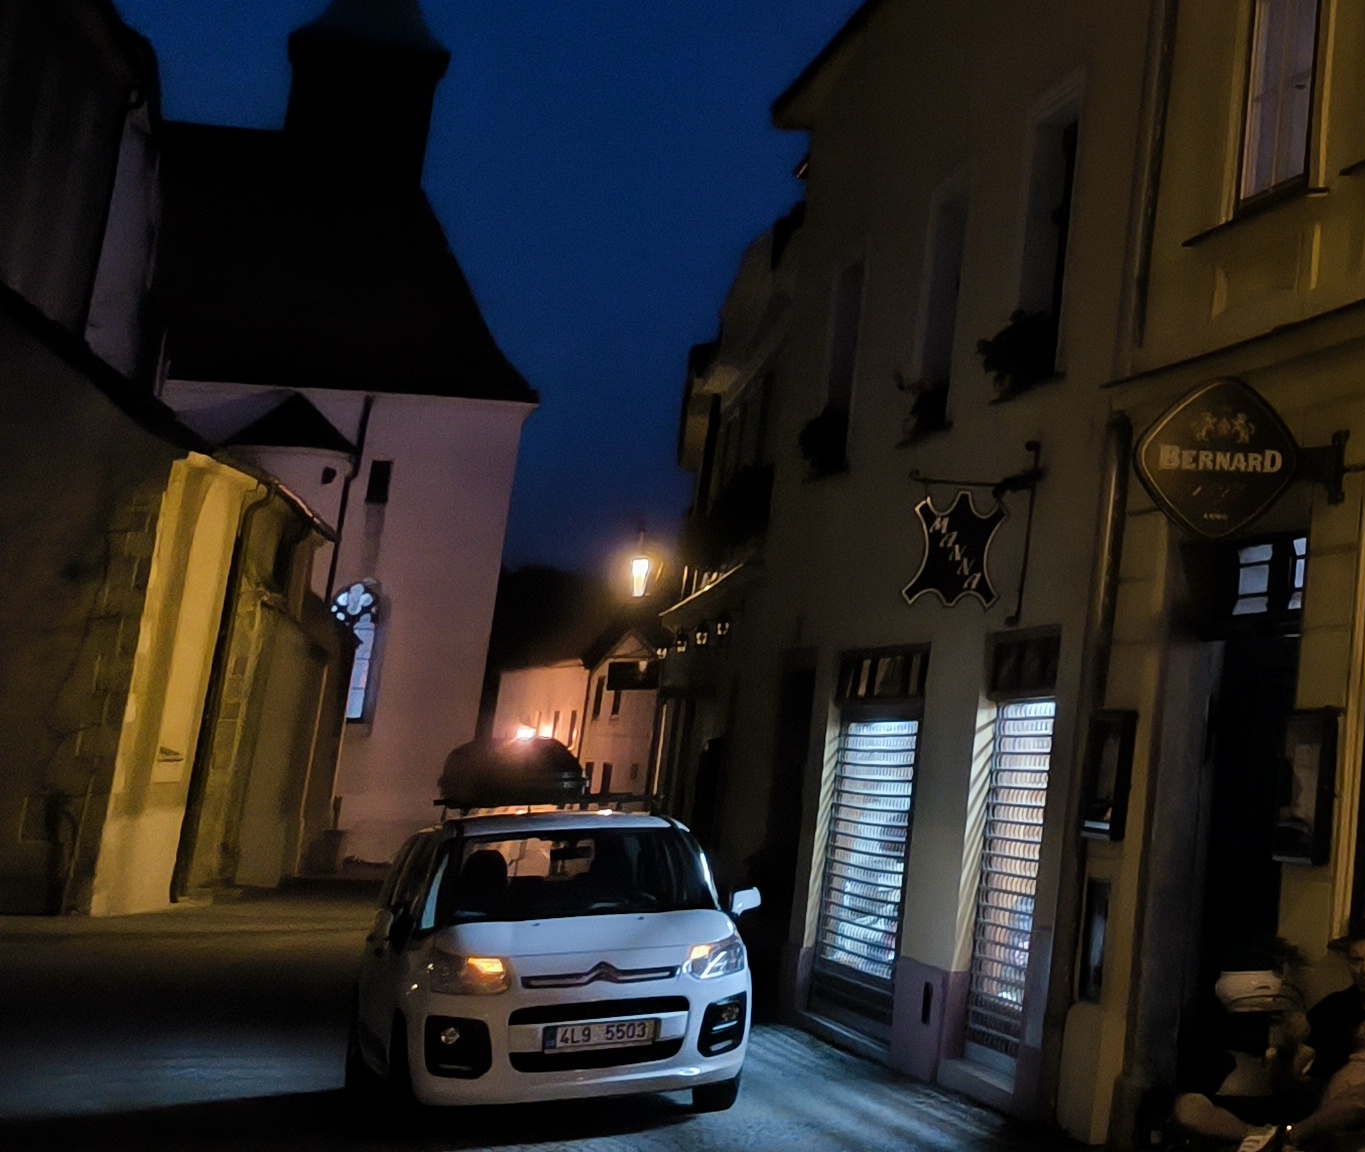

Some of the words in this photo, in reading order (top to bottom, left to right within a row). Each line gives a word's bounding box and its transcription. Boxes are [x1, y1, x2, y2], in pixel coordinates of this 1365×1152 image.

[1158, 444, 1283, 474] BERNARD
[560, 1026, 592, 1045] 4L9
[605, 1021, 647, 1041] 5503
